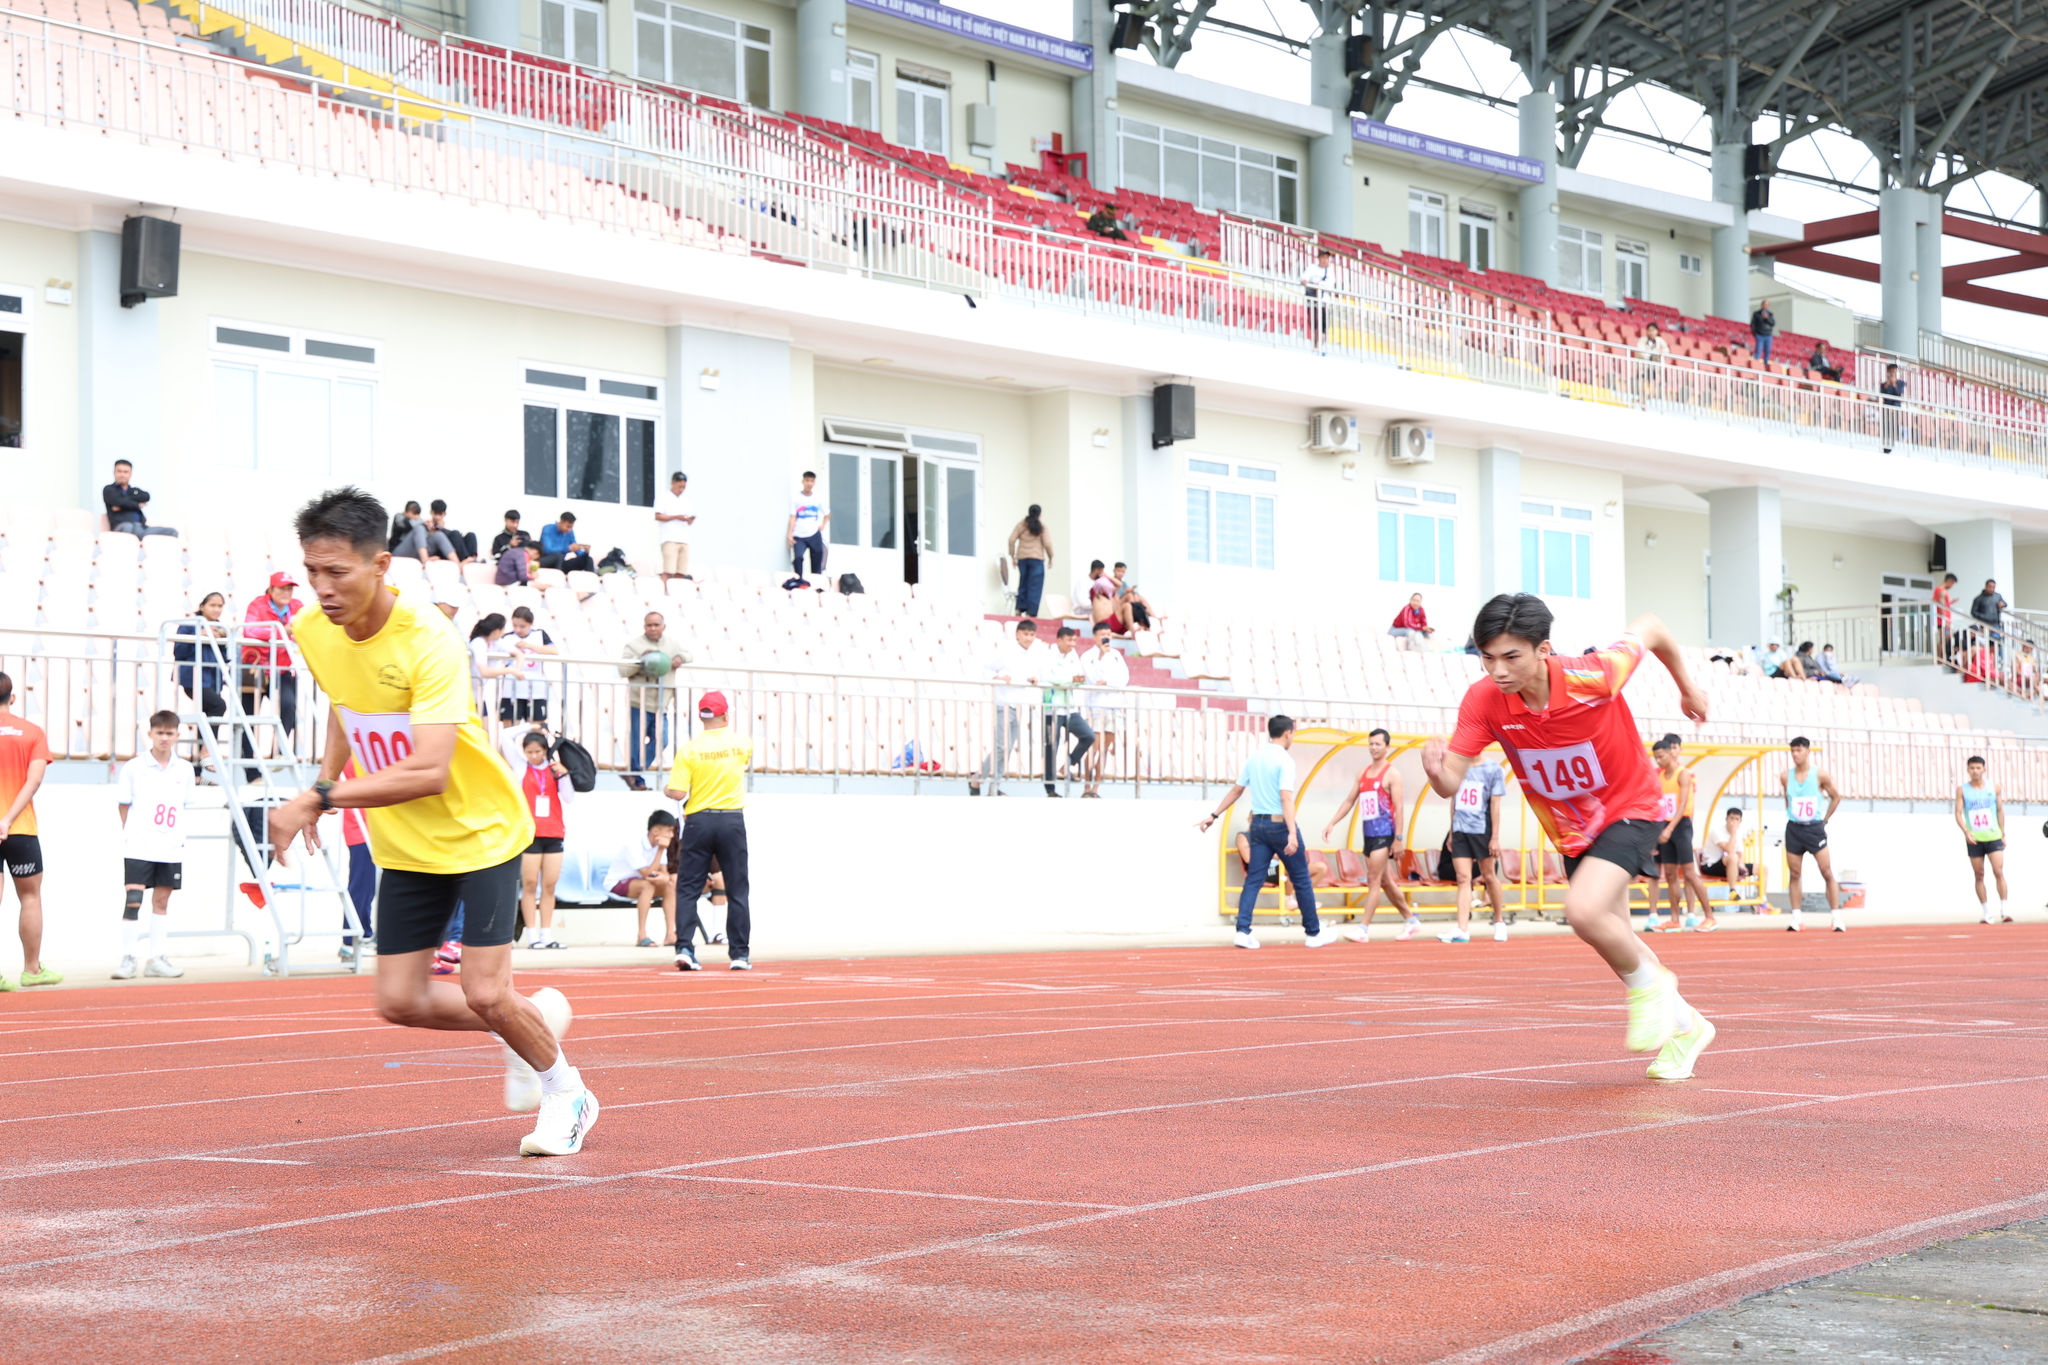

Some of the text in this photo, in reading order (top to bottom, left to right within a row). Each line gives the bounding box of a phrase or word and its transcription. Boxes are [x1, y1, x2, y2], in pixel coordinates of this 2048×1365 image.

[904, 1, 925, 19] DỰNG
[925, 7, 936, 21] VÀ
[936, 10, 952, 27] BẢO
[952, 14, 963, 30] VỆ
[963, 17, 973, 33] TỔ
[973, 21, 993, 38] QUỐC
[993, 27, 1009, 43] VIỆT
[1009, 32, 1026, 47] NAM
[1026, 36, 1037, 50] XÃ
[1037, 39, 1050, 55] HỘI
[1050, 42, 1065, 58] CHỦ
[1356, 122, 1370, 137] THỂ
[1370, 126, 1388, 142] THAO
[1388, 130, 1408, 146] ĐOÀN
[1407, 135, 1421, 150] KẾT
[1425, 140, 1447, 156] TRUNG
[1447, 145, 1465, 161] THỰC
[1468, 150, 1482, 163] CAO
[1482, 154, 1508, 171] THƯỢNG
[1508, 159, 1517, 172] VÀ
[1517, 161, 1532, 176] TIẾN
[1532, 164, 1541, 179] BỘ
[353, 727, 414, 775] 100
[1531, 755, 1595, 793] 149
[1361, 798, 1377, 816] 138
[1460, 787, 1478, 806] 46
[1796, 801, 1814, 817] 76
[154, 803, 177, 828] 86
[1973, 813, 1989, 828] 44
